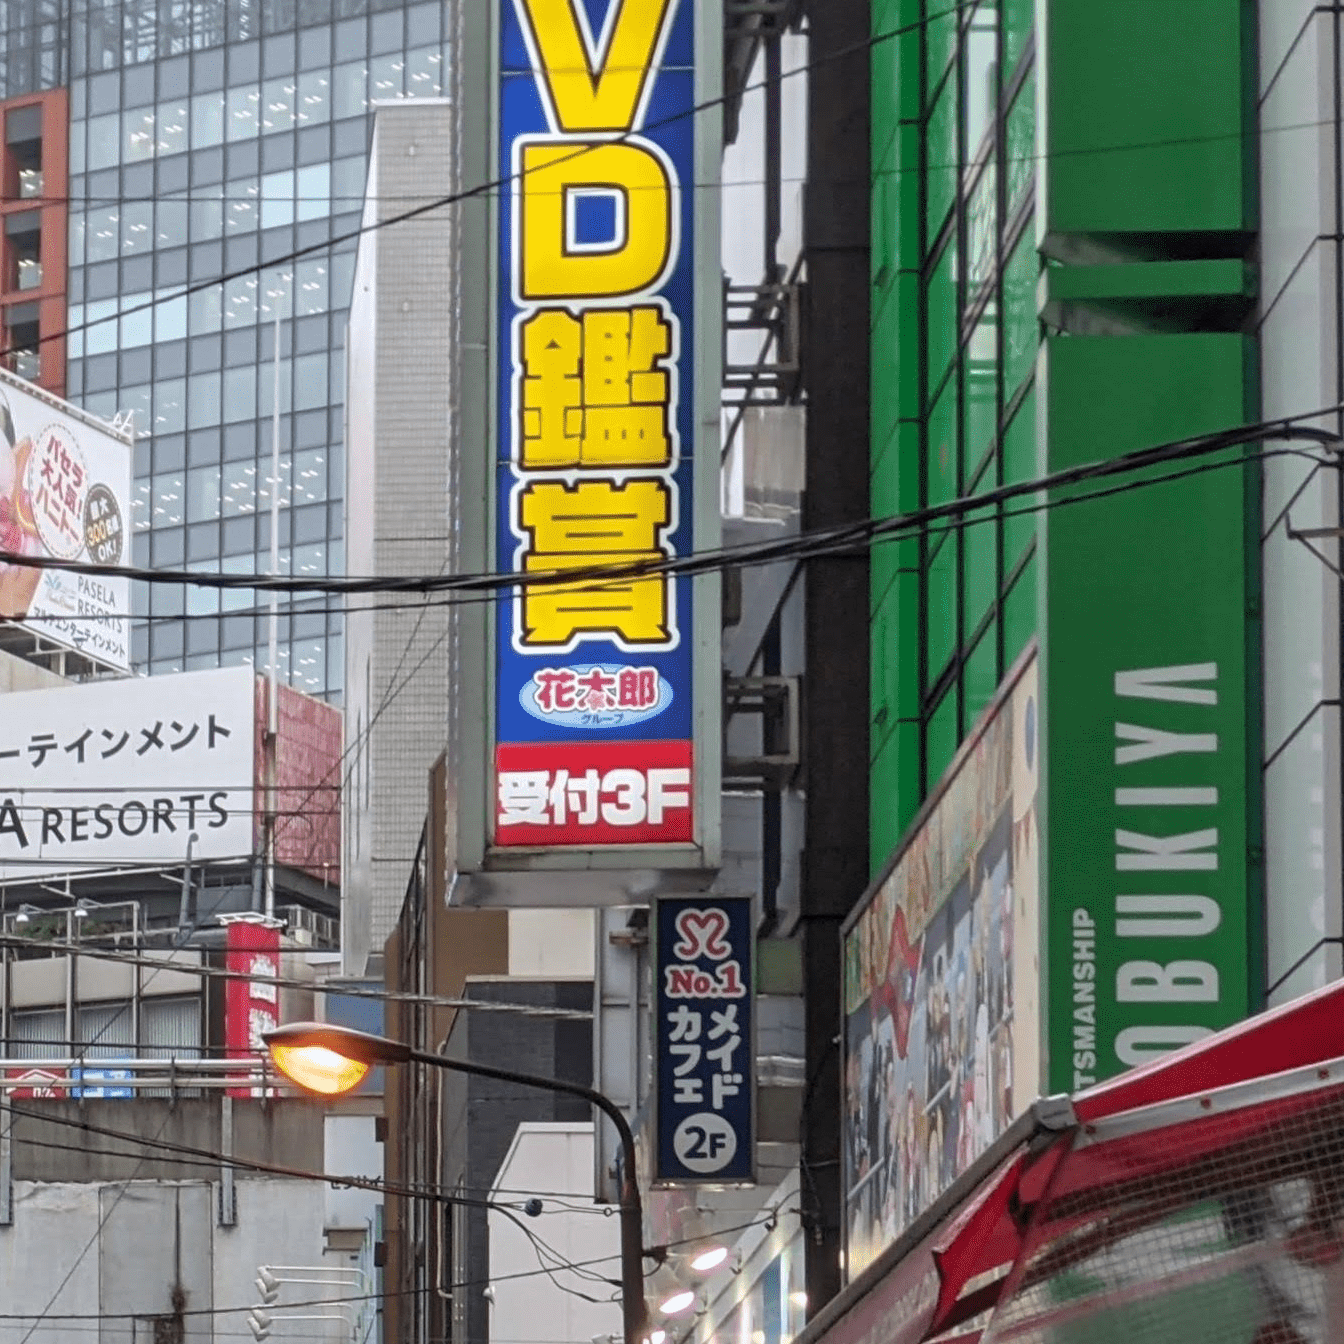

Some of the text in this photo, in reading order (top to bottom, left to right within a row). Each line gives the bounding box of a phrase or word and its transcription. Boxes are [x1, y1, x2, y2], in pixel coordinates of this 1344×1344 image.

[78, 577, 116, 607] PASELA
[535, 667, 658, 711] 花太郎
[42, 791, 229, 846] RESORTS
[497, 769, 691, 828] 受付3F
[664, 963, 746, 999] No.1
[667, 1005, 704, 1105] カフェ
[705, 1005, 741, 1110] メイド
[683, 1128, 729, 1160] 2F
